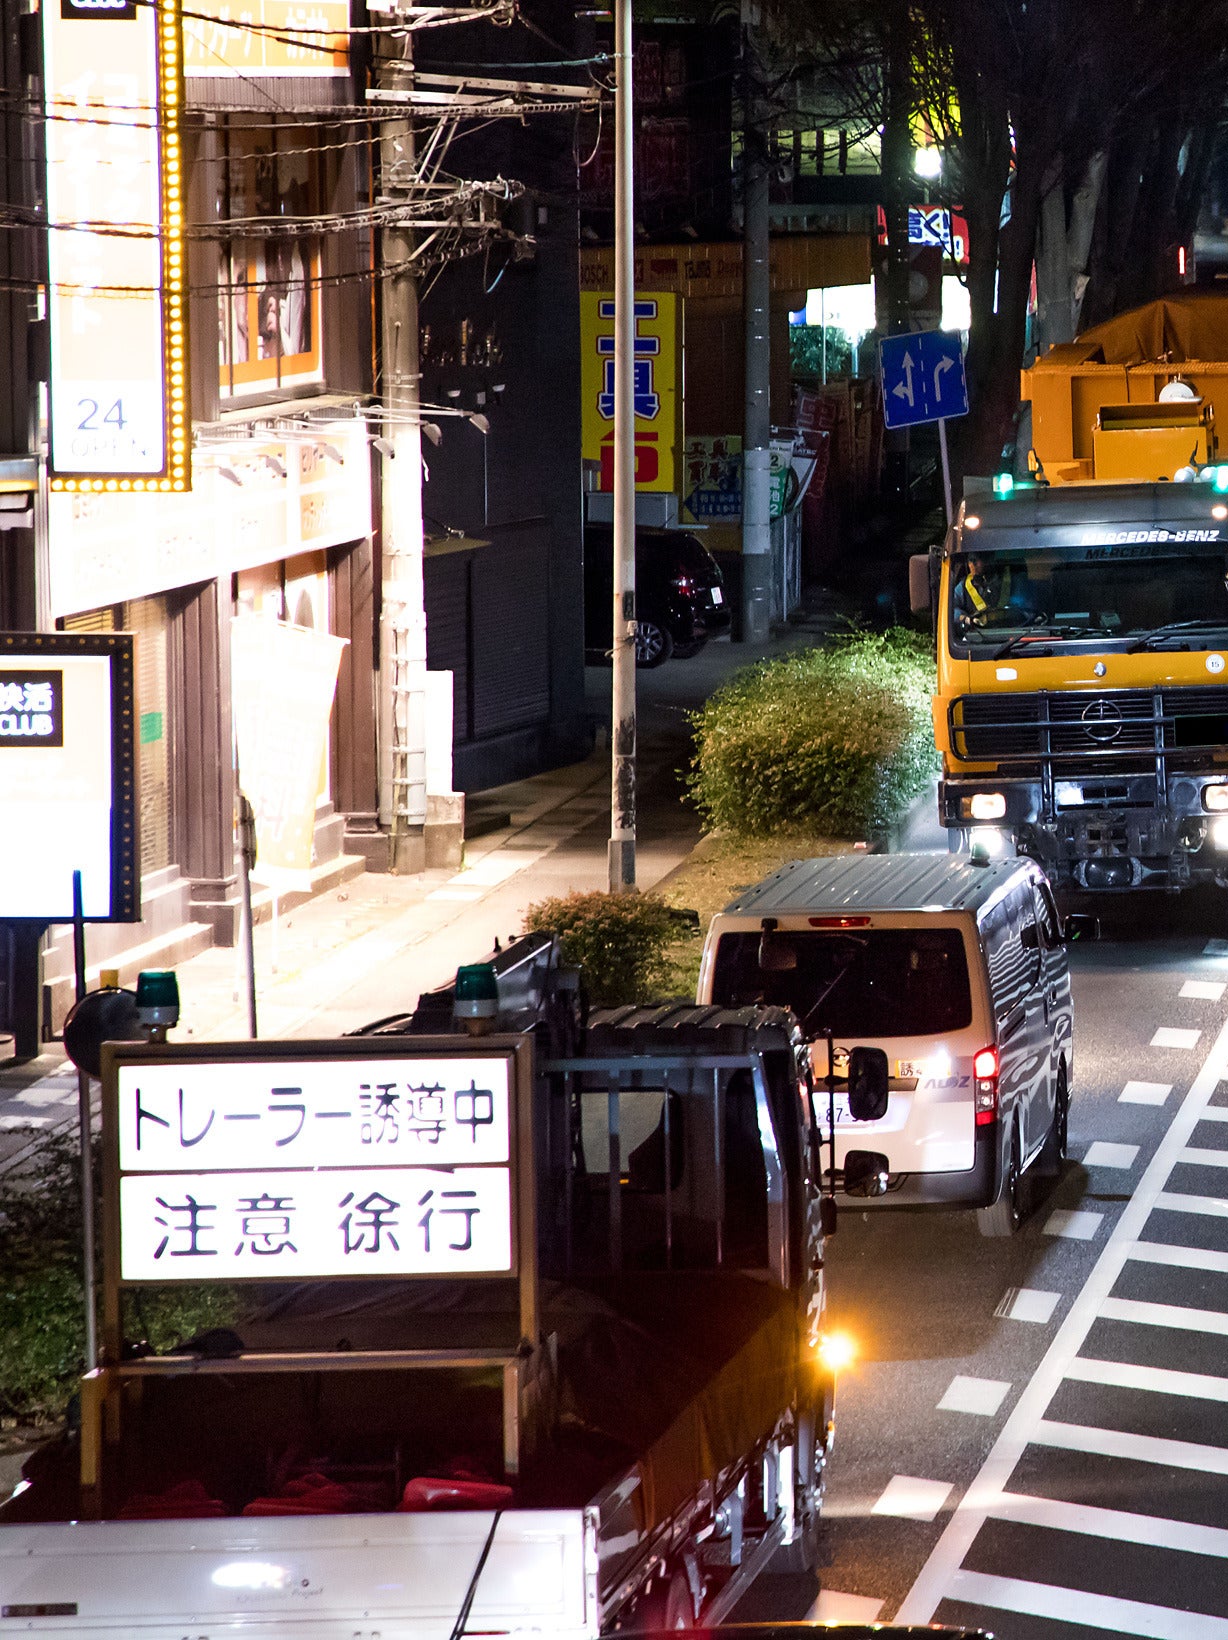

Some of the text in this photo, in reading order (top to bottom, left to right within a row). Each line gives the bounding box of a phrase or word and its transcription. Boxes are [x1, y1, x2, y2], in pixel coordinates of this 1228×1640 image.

[77, 398, 128, 430] 24
[0, 713, 53, 736] CLUB
[135, 1079, 495, 1151] トレーラー誘導中
[154, 1189, 481, 1259] 注意 徐行
